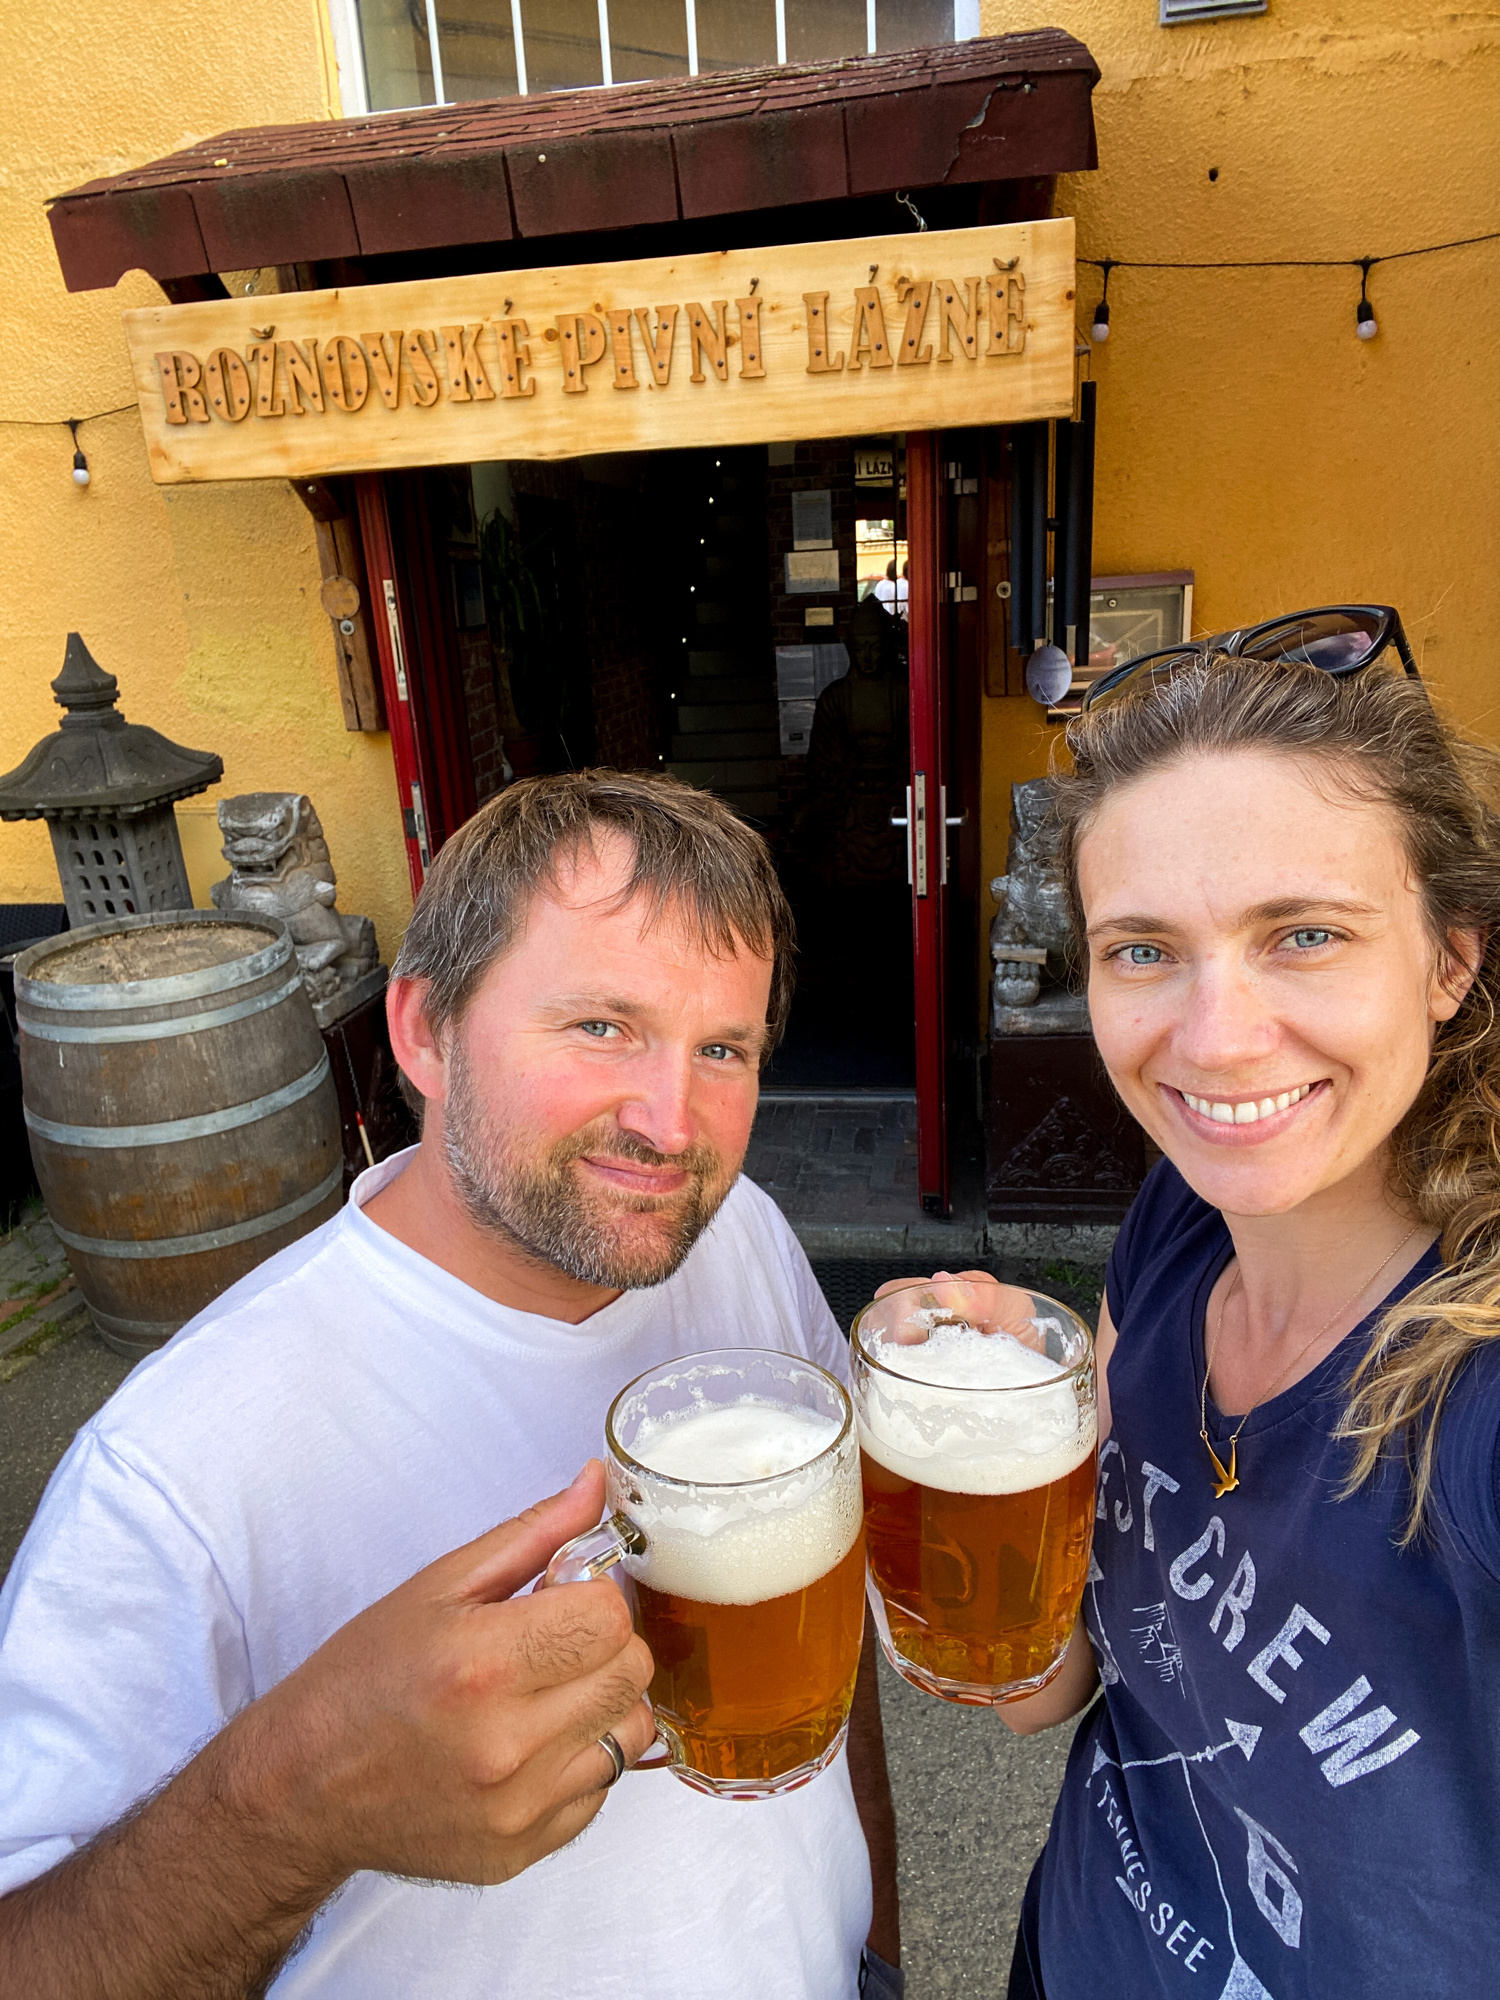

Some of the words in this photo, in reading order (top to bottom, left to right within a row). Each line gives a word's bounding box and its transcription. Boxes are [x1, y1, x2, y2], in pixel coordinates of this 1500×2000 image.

[155, 297, 535, 425] ROŽNOVSKÉ
[555, 277, 766, 393] PIVNÍ
[802, 256, 1027, 374] LÁZNĚ
[1168, 1515, 1422, 1789] CREW
[1097, 1779, 1215, 1973] TENNESSEE
